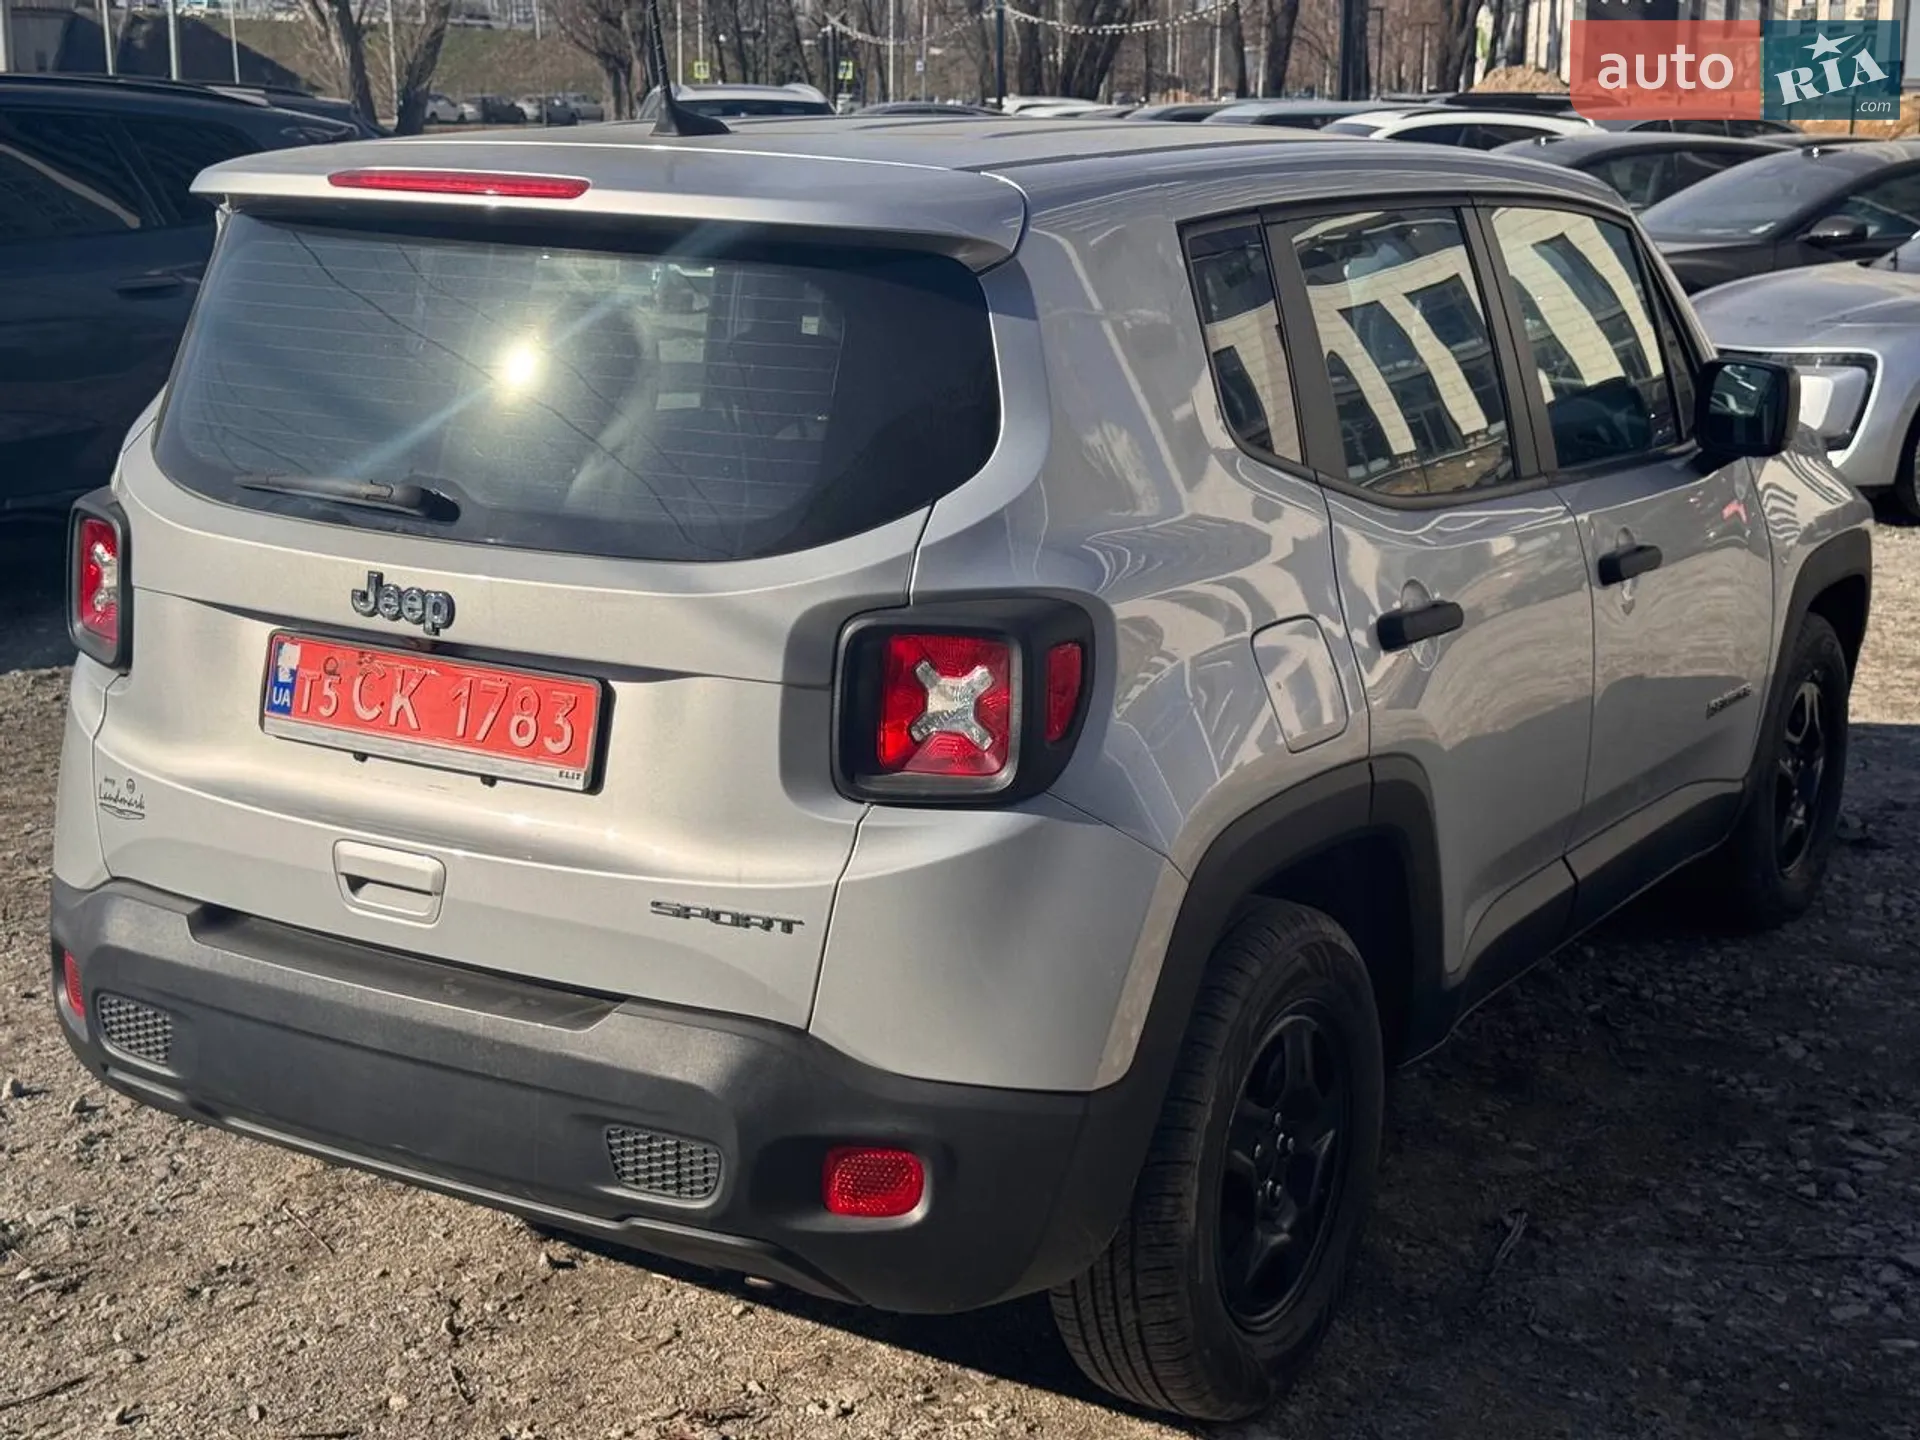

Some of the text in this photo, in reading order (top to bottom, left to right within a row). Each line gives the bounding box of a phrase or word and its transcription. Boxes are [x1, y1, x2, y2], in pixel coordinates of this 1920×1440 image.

[351, 570, 456, 636] Jeep
[272, 686, 291, 707] UA
[353, 661, 428, 731] CK
[450, 676, 578, 755] 1783
[650, 899, 805, 935] SPORT
